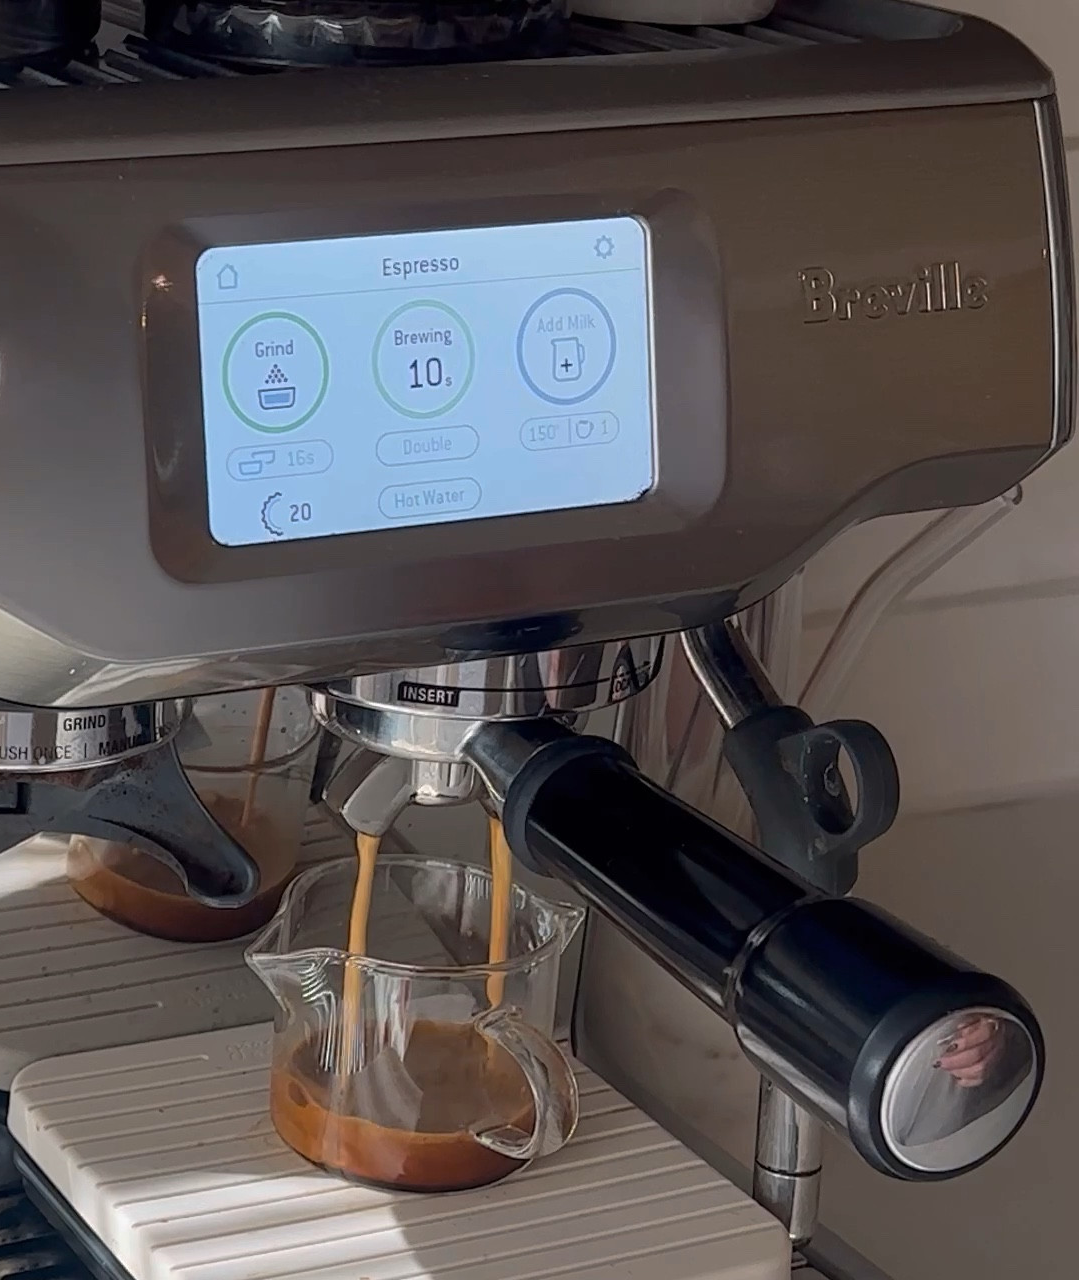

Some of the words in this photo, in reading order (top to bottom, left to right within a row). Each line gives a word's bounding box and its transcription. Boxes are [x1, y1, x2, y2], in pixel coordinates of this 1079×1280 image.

[382, 257, 459, 280] Espresso
[796, 260, 989, 324] Breville
[537, 317, 563, 333] Add
[568, 314, 596, 331] Milk
[394, 328, 452, 346] Brewing
[254, 339, 294, 358] Grind
[403, 436, 452, 455] Double
[394, 493, 421, 509] Hot
[423, 488, 465, 506] Water
[289, 502, 312, 522] 20
[403, 685, 456, 705] INSERT
[63, 714, 107, 732] GRIND
[33, 744, 73, 760] ONCE
